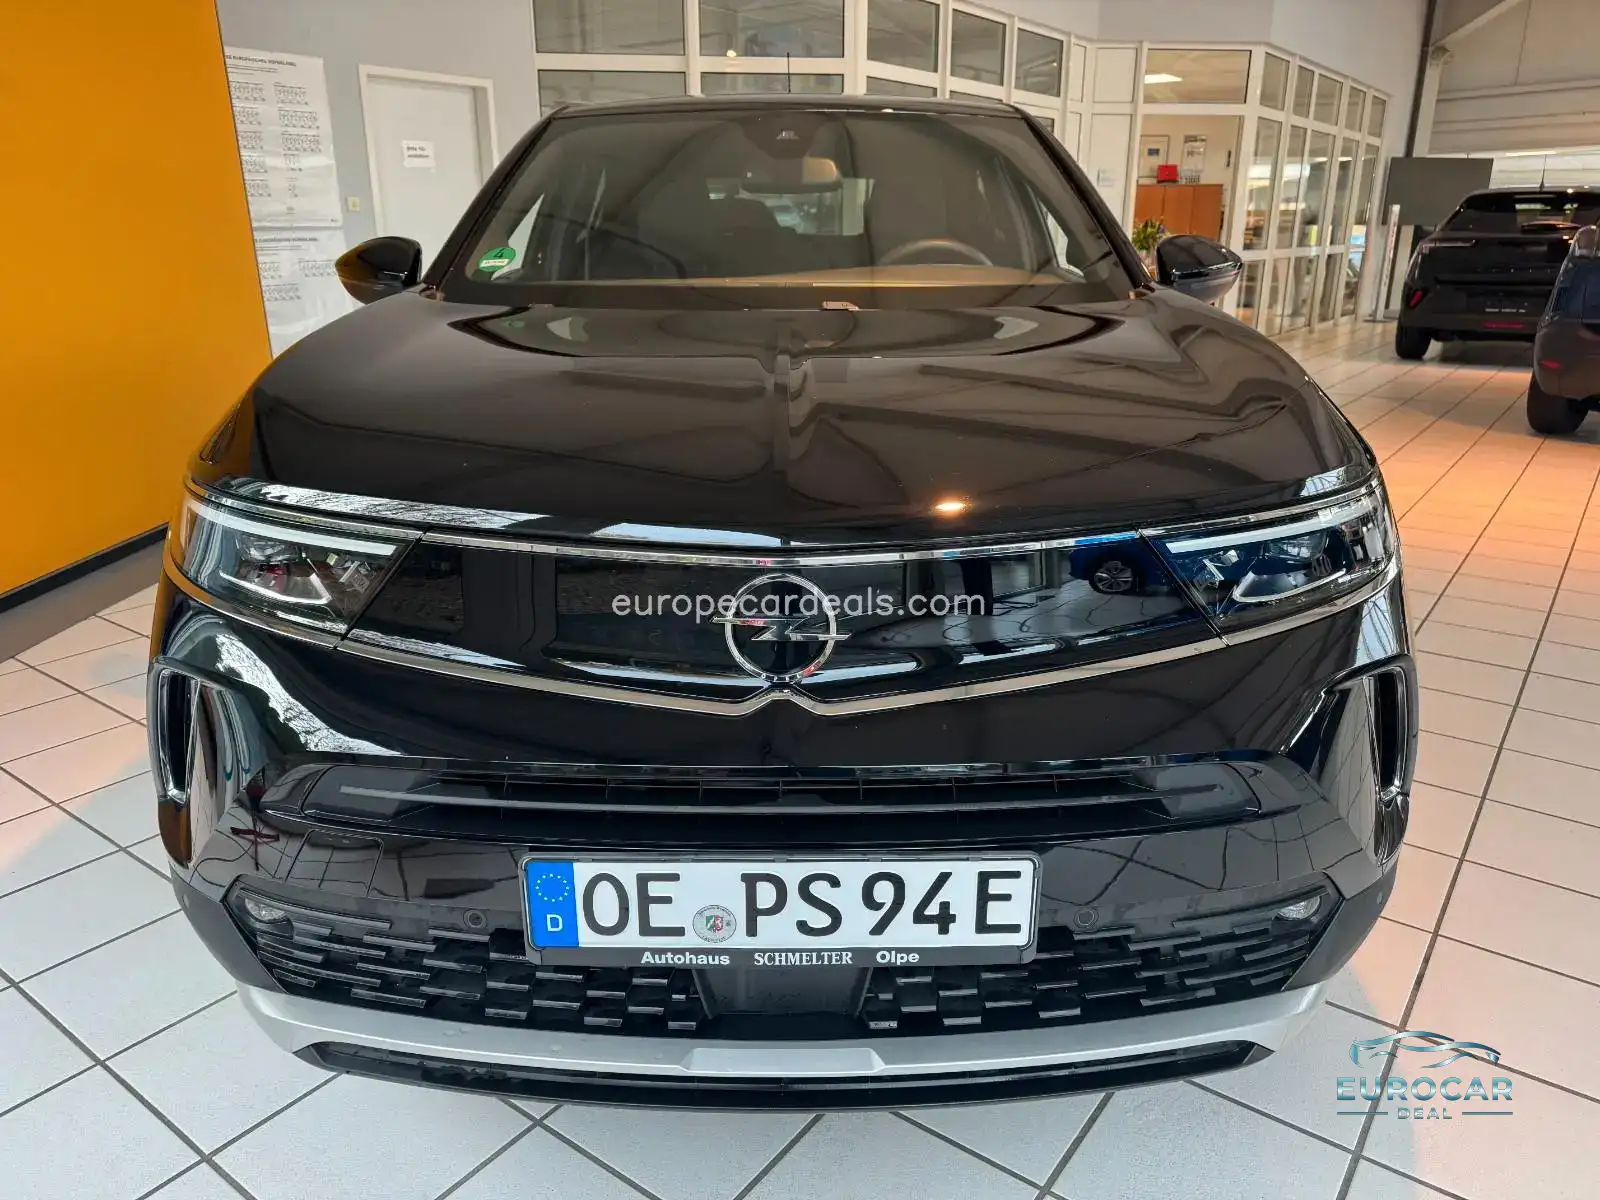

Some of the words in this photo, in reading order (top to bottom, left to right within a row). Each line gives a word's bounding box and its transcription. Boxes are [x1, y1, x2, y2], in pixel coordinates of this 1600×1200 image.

[582, 871, 687, 938] OE
[740, 871, 843, 938] PS
[546, 913, 564, 933] D
[640, 950, 731, 966] Autohaus
[753, 951, 853, 967] SCHMELTER
[875, 949, 920, 966] Olpe
